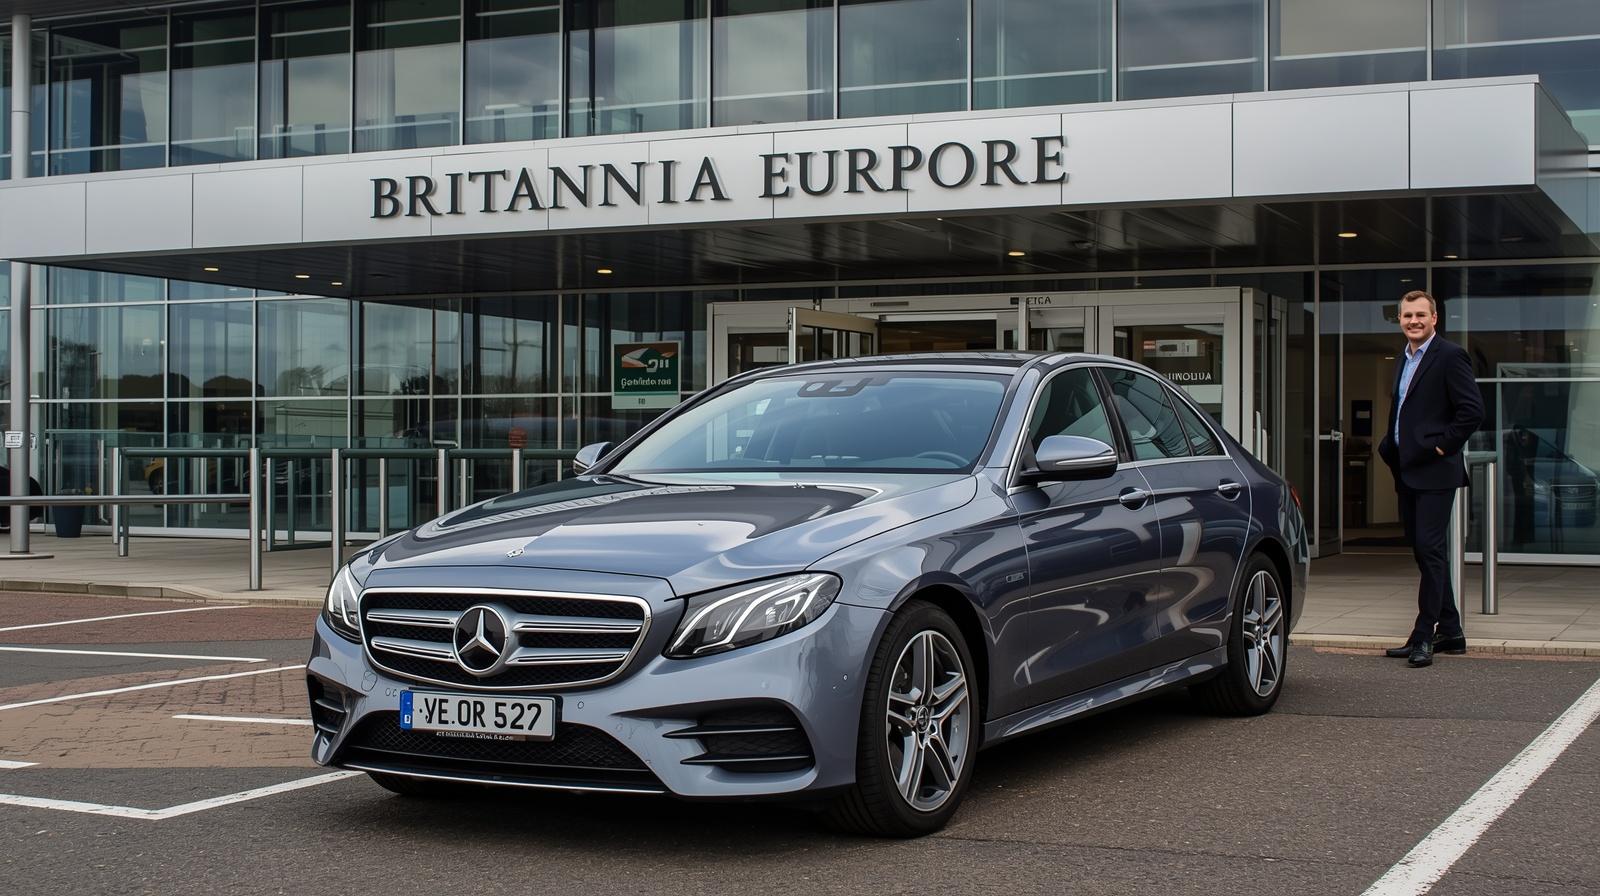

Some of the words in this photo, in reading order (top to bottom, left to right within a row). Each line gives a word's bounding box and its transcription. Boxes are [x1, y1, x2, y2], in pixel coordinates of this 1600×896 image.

[370, 156, 730, 219] BRITANNIA
[758, 135, 1068, 199] EURPORE
[494, 701, 542, 731] 527
